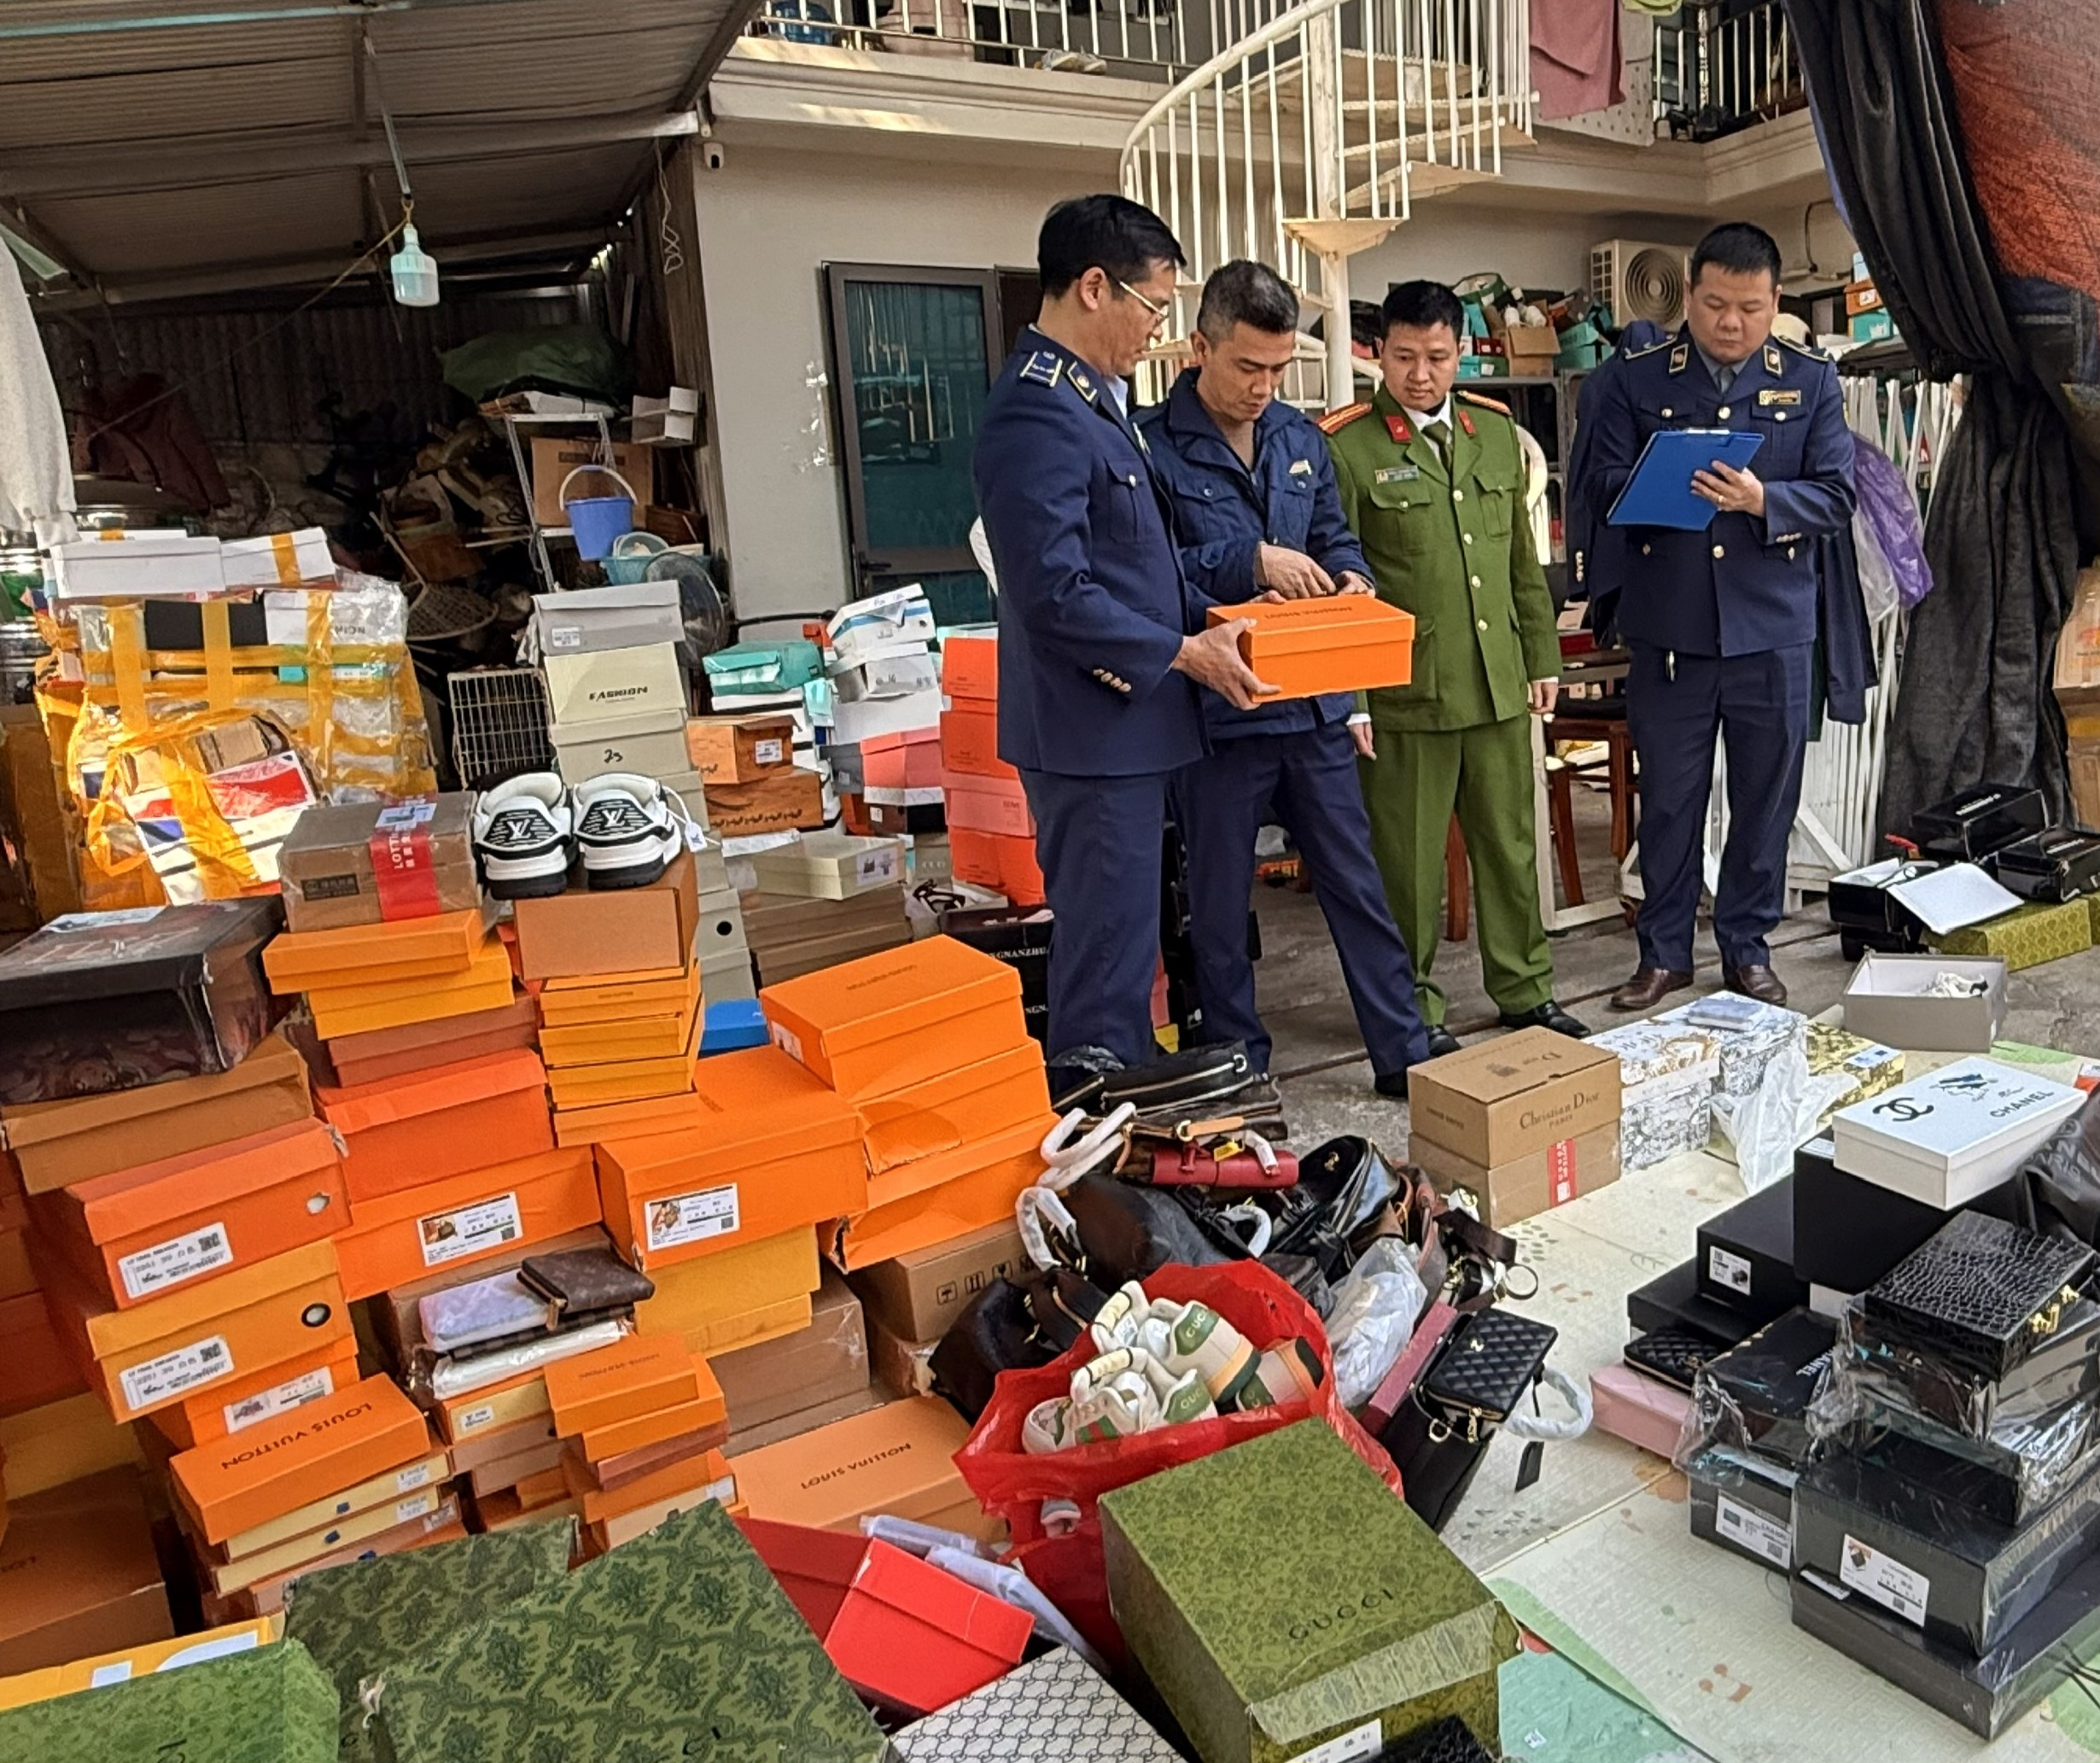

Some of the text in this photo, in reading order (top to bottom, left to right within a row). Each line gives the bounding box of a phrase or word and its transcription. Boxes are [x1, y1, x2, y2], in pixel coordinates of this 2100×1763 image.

[1519, 1092, 1601, 1131] Christian Dior
[1989, 1089, 2055, 1118] CHANEL
[221, 1403, 372, 1470] LOUIS VUITTON
[801, 1442, 912, 1490] LOUIS VUITTON
[1288, 1589, 1394, 1640] GUCCI
